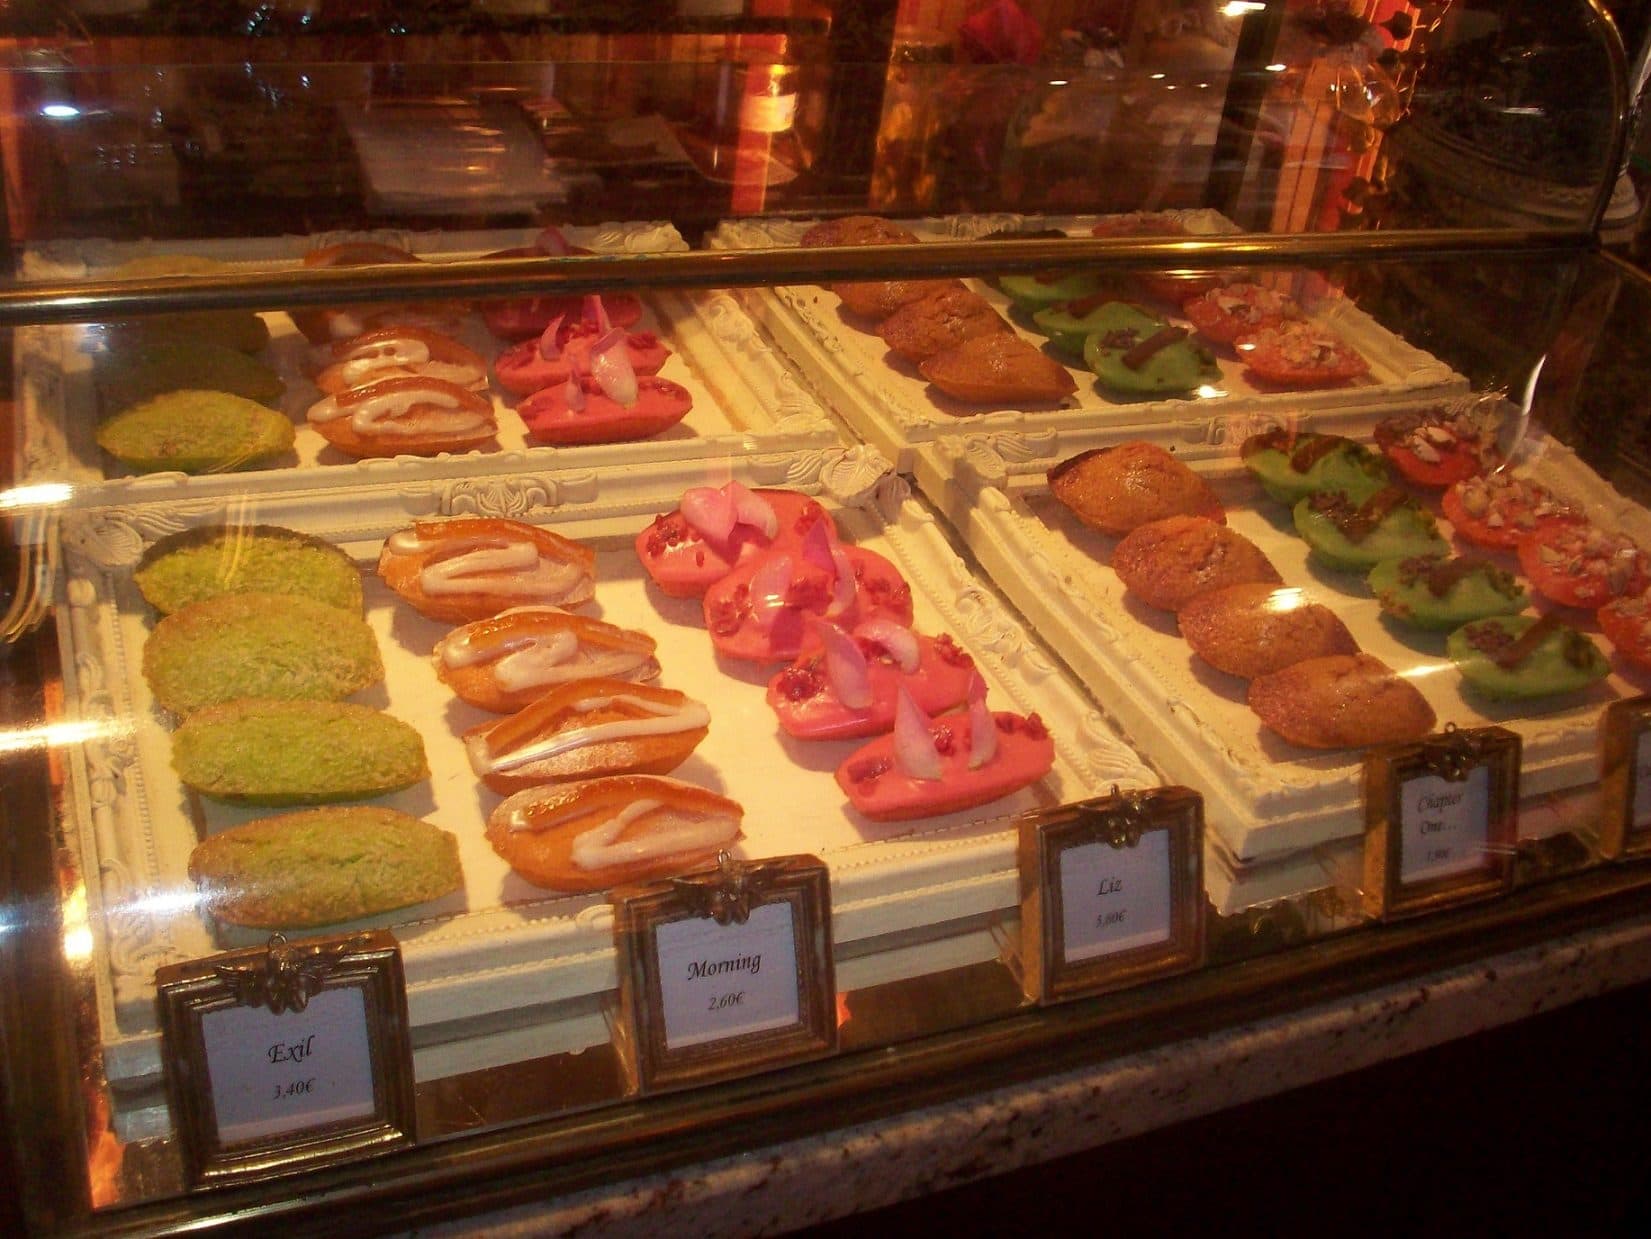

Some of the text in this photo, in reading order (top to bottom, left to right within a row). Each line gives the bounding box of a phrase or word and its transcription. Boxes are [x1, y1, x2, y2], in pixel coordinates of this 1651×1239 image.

[1096, 876, 1123, 896] Liz
[687, 952, 762, 981] Morning
[708, 991, 745, 1011] 2,60€
[267, 1035, 316, 1064] Exil
[272, 1078, 316, 1100] 3,40€
